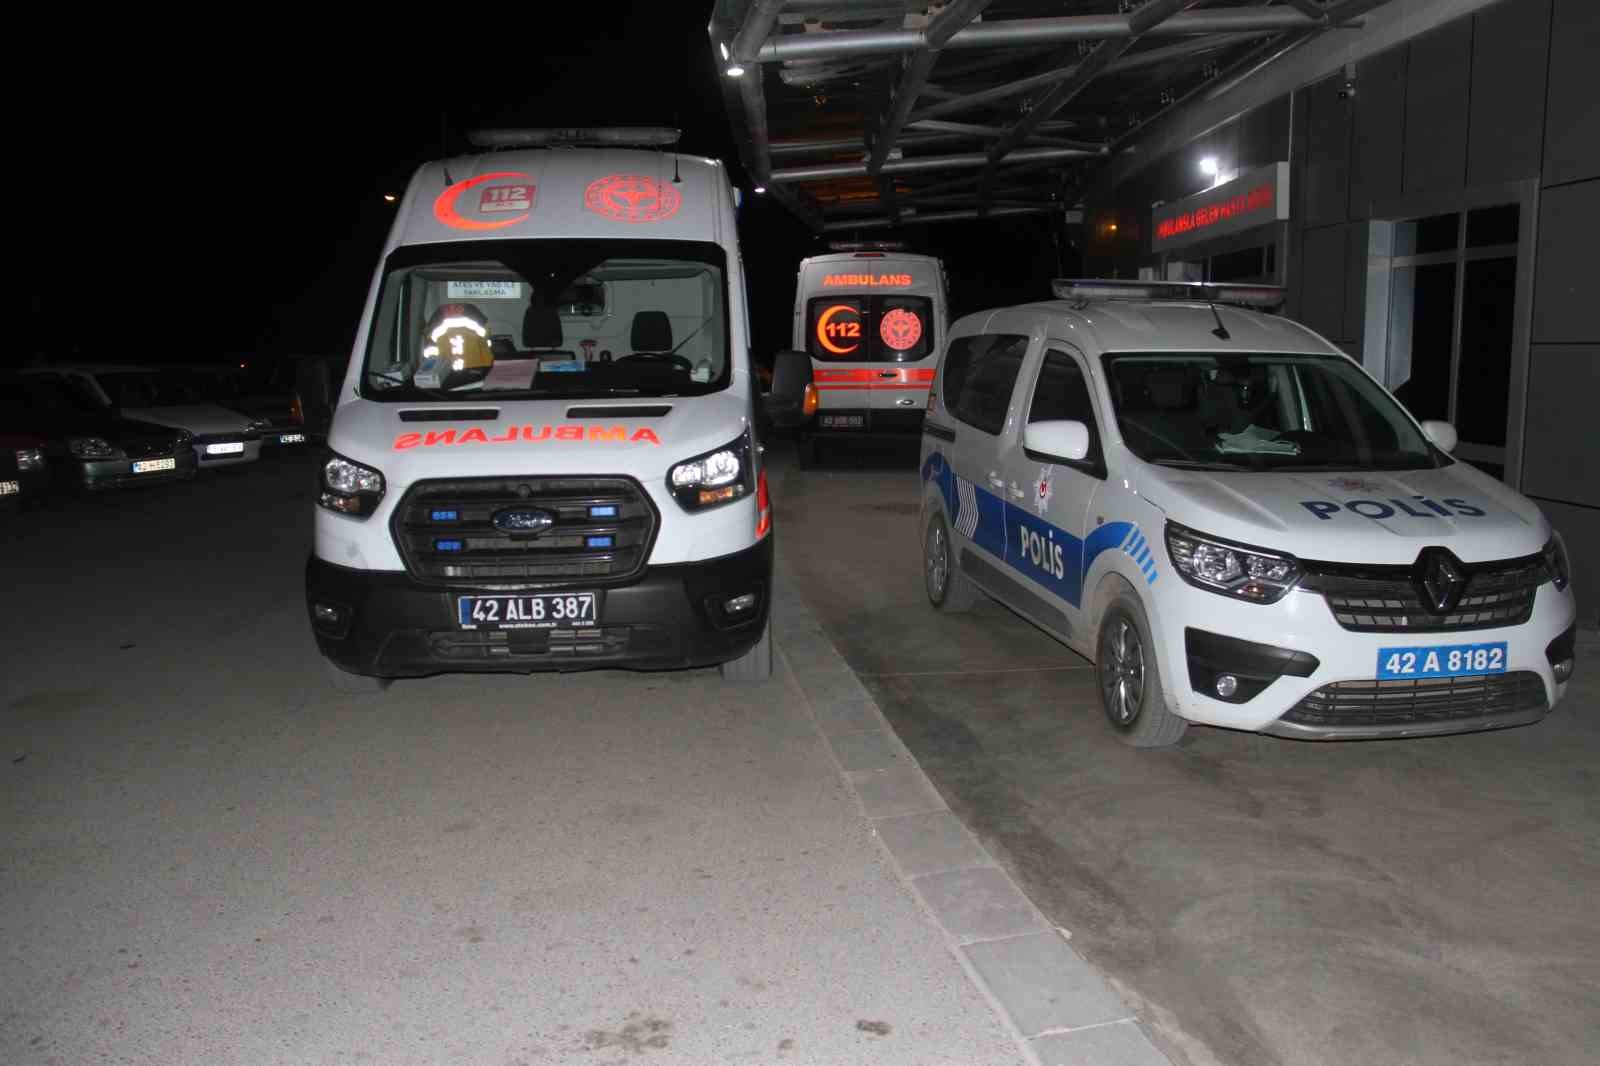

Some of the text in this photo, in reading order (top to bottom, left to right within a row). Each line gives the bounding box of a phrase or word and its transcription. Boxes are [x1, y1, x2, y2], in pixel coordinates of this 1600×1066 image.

[490, 187, 527, 201] 112
[823, 273, 913, 287] AMBULANS
[826, 321, 860, 337] 112
[1300, 495, 1487, 521] POLİS
[1020, 525, 1065, 580] POLİS
[472, 596, 592, 621] 42 ALB 387
[1385, 647, 1503, 674] 42 A 8182
